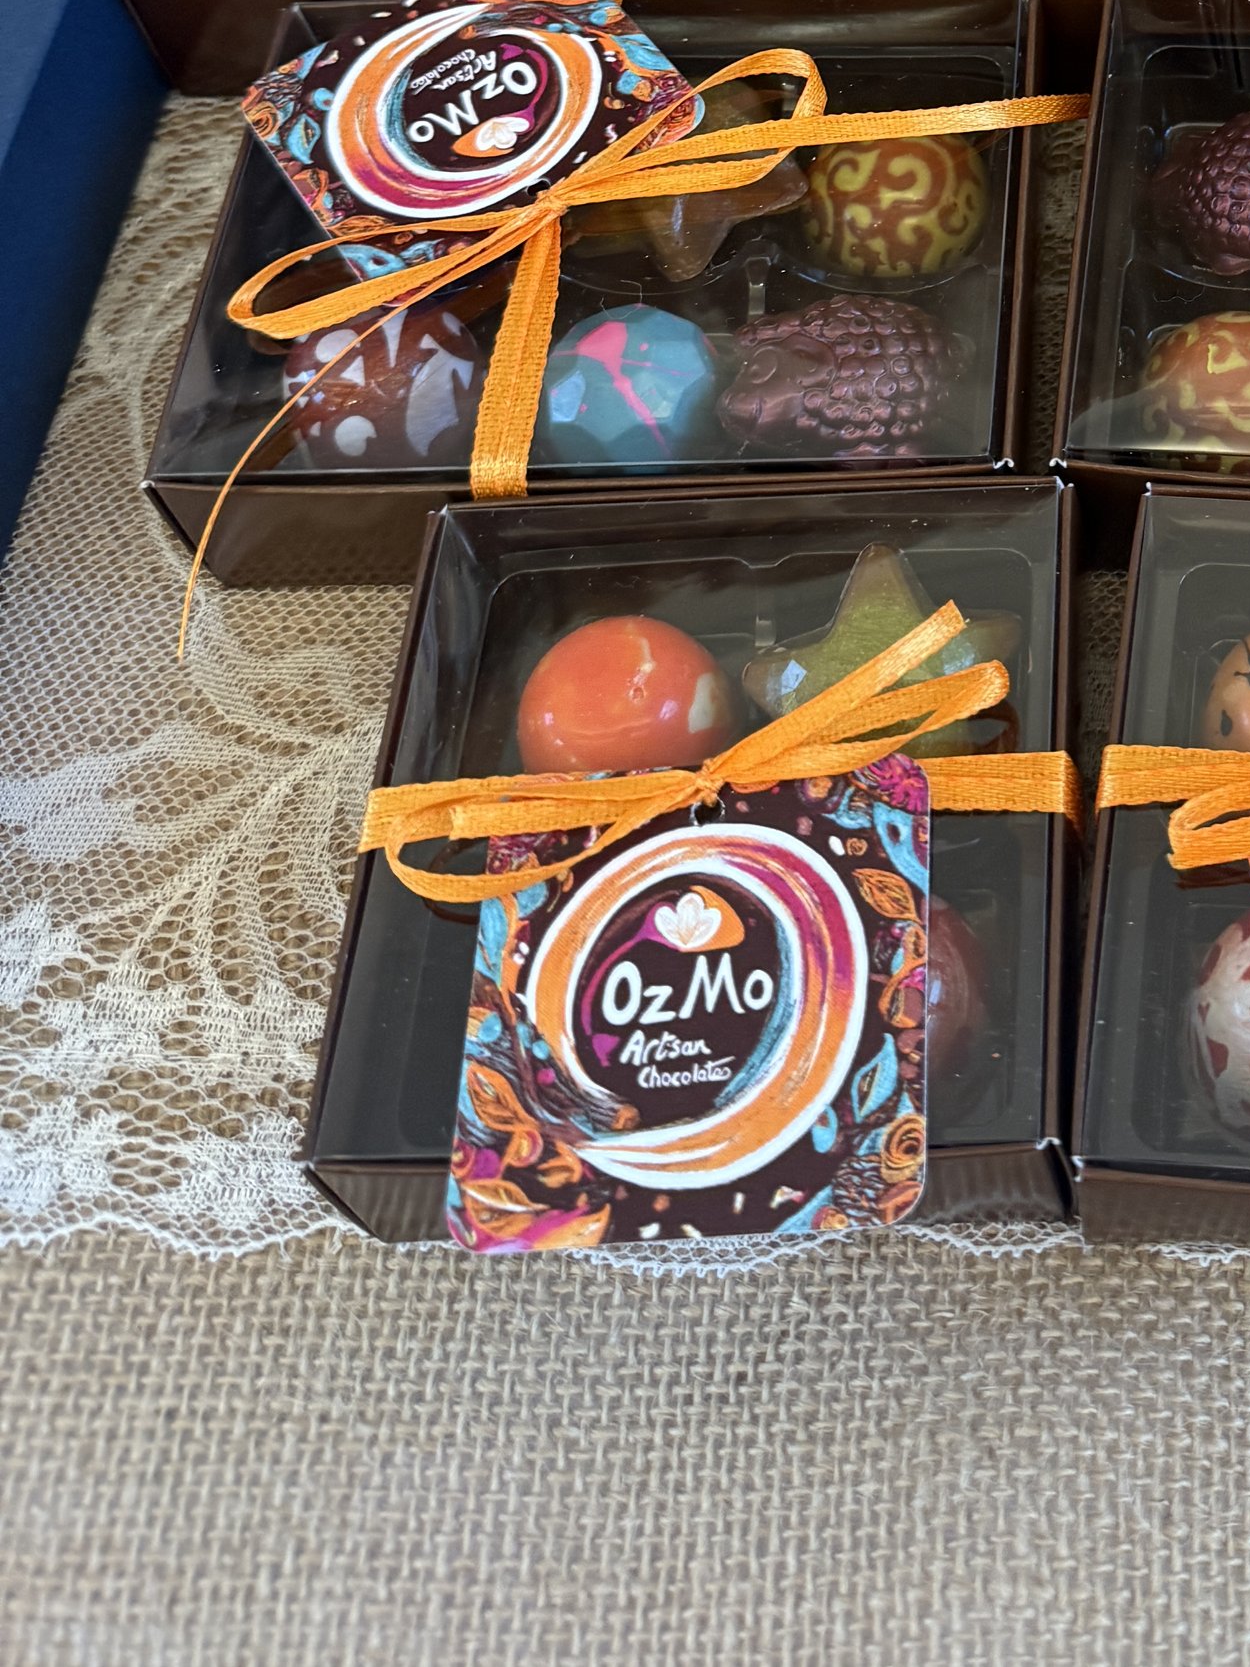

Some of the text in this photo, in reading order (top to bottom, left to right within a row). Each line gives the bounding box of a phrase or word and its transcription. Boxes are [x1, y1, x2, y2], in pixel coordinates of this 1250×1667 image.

[408, 61, 538, 143] OzMo
[602, 952, 774, 1026] OzMo
[619, 1029, 712, 1066] Artisan
